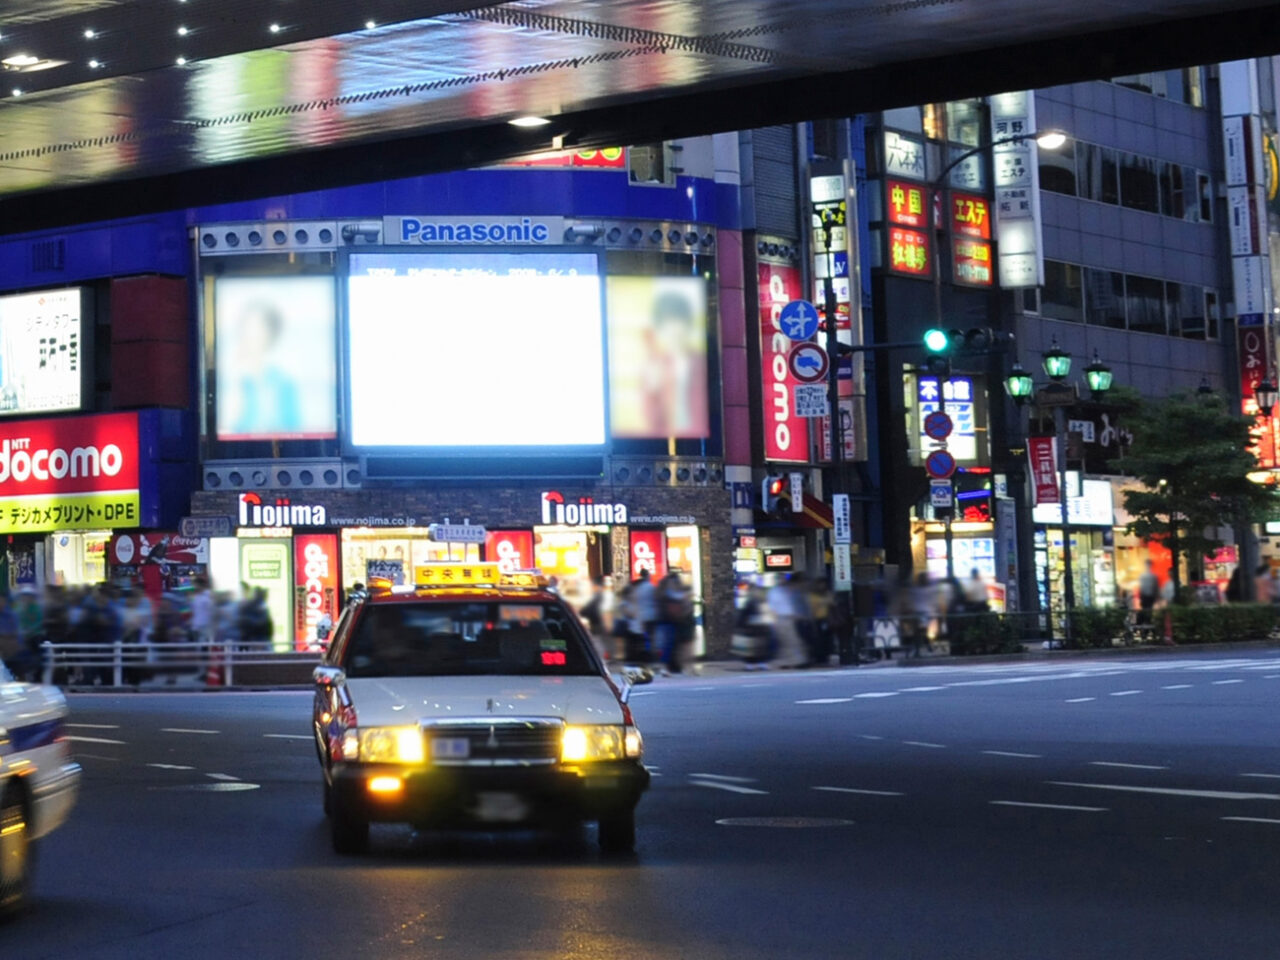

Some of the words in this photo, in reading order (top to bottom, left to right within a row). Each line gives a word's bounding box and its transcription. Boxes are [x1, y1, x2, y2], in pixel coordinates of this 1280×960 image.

[891, 185, 922, 215] 中国
[955, 199, 986, 226] エステ
[401, 218, 548, 242] Panasonic
[11, 438, 31, 451] NTT
[330, 515, 417, 527] www.nojima.co.jp
